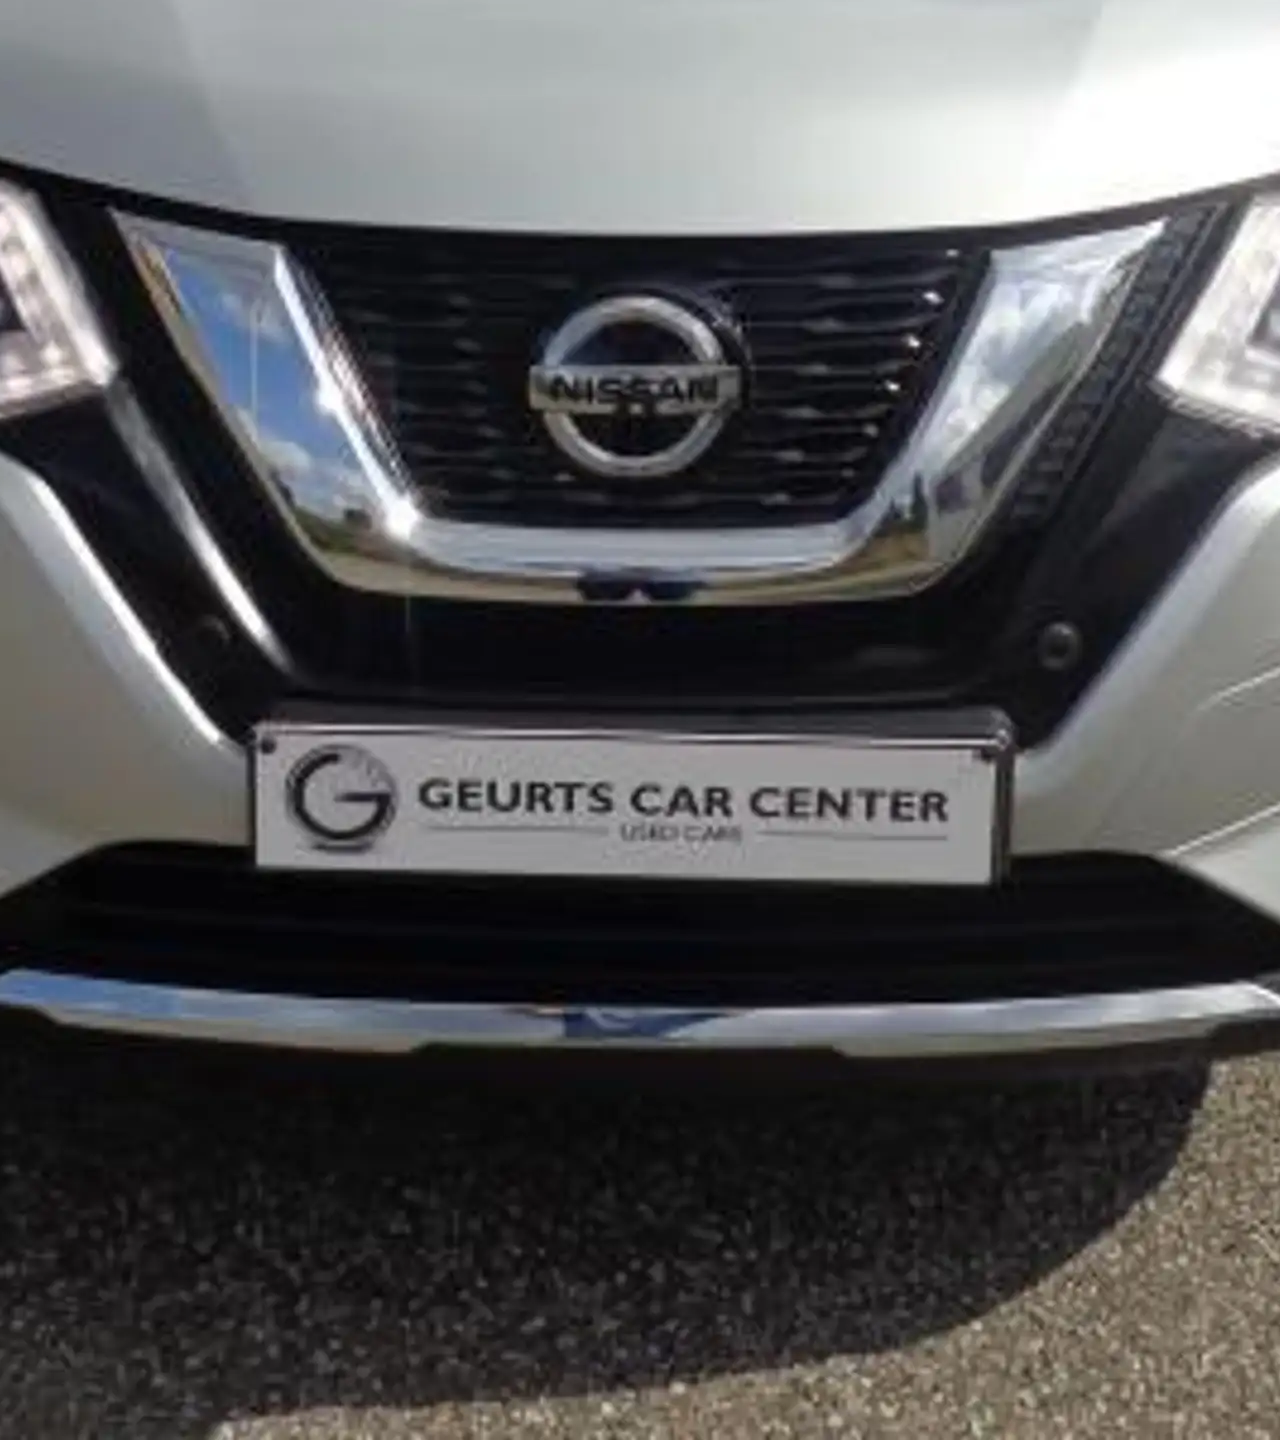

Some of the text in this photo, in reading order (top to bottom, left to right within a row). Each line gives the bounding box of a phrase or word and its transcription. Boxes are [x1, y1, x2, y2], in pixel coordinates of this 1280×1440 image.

[549, 375, 718, 405] NISSAN
[418, 776, 950, 824] GEURTS CAR CENTER
